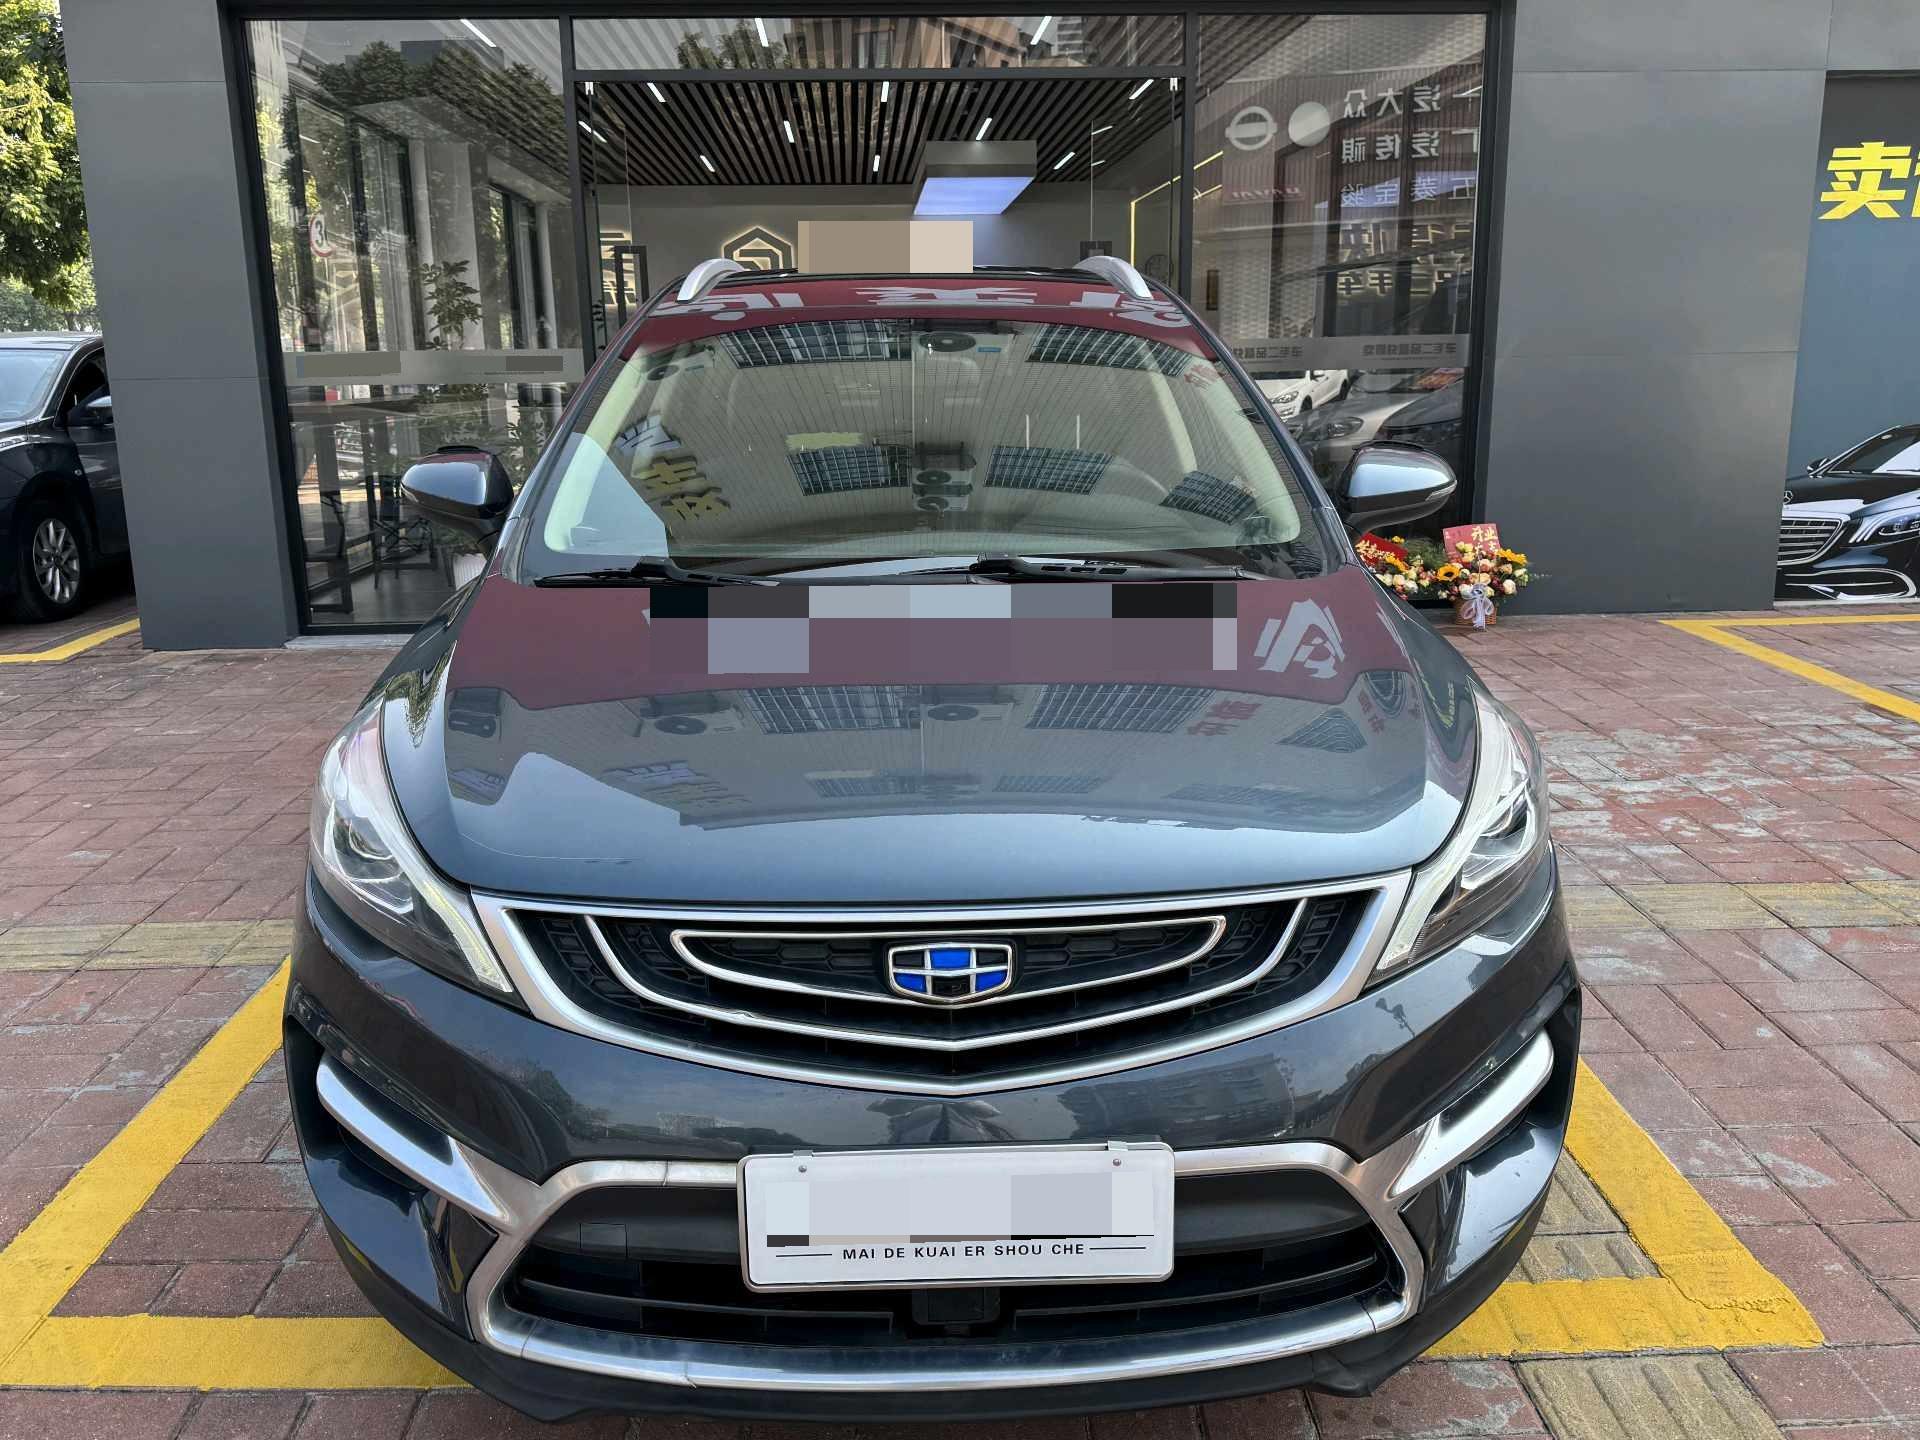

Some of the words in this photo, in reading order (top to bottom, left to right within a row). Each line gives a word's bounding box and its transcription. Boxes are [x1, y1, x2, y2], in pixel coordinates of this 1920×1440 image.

[1817, 140, 1920, 220] 卖
[843, 1248, 875, 1260] MAI
[884, 1247, 905, 1259] DE
[914, 1246, 956, 1258] KUAI
[964, 1245, 985, 1256] ER
[994, 1244, 1042, 1256] SHOU
[1051, 1243, 1084, 1255] CHE
